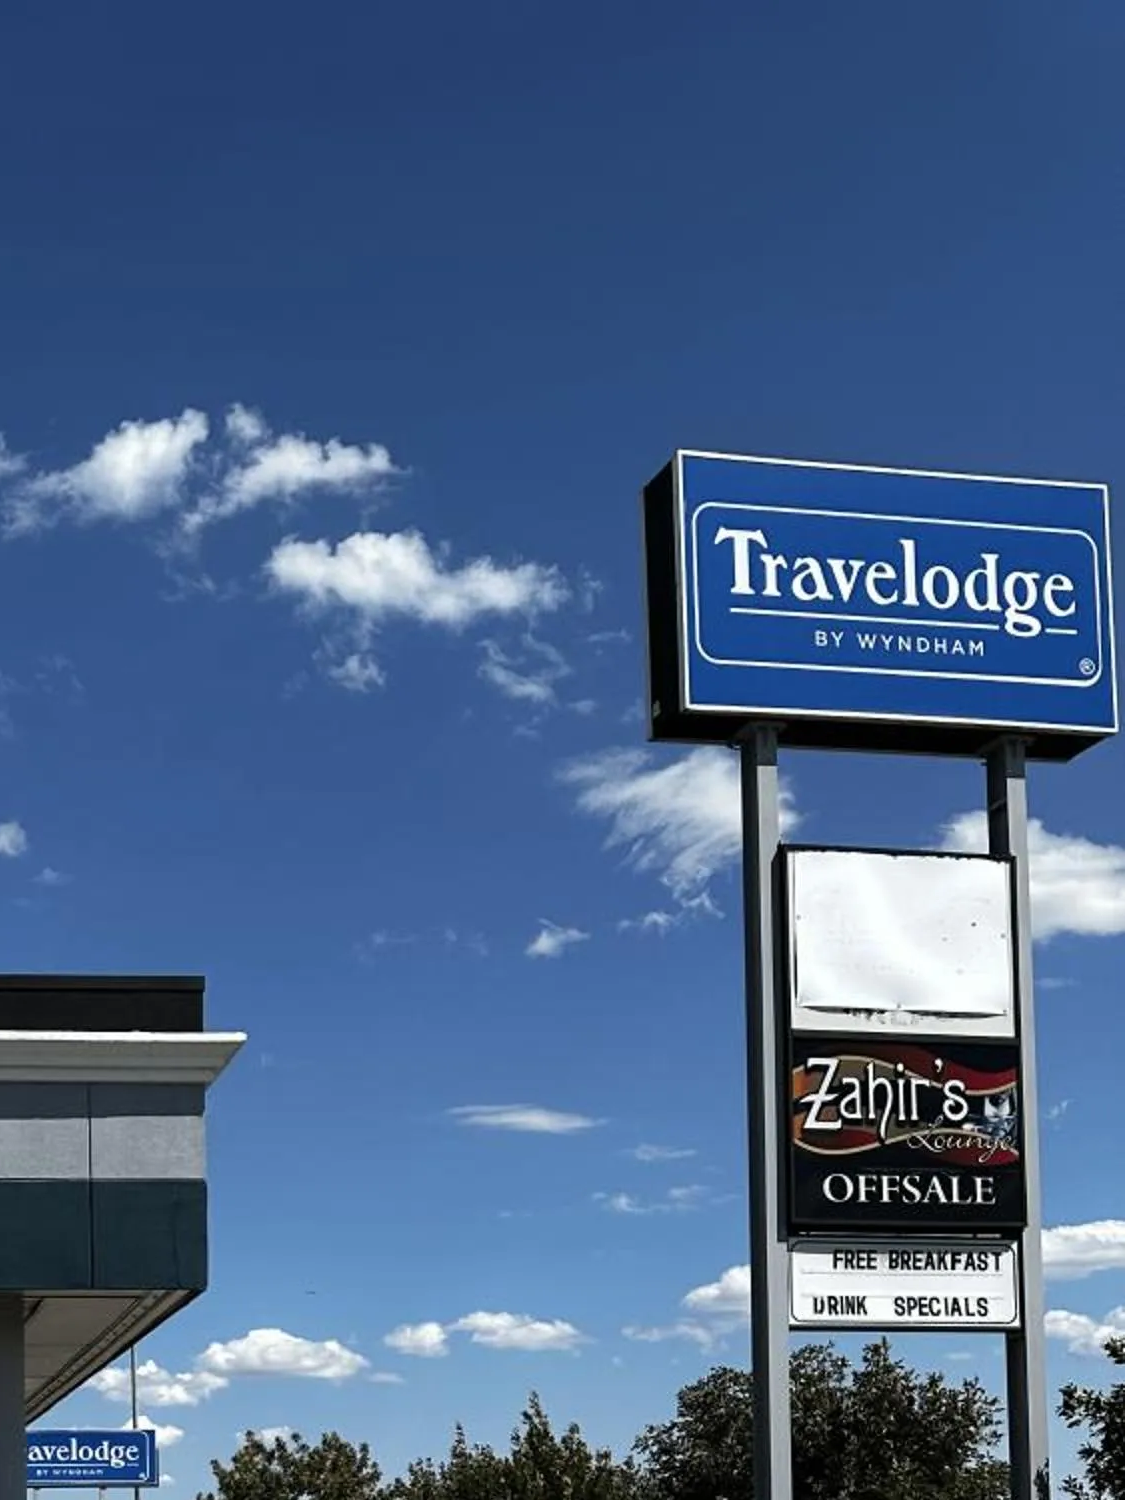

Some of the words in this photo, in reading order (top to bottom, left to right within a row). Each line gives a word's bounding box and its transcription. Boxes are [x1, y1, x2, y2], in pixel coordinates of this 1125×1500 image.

[713, 525, 1077, 638] Travelodge
[814, 630, 845, 648] BY
[857, 632, 985, 657] WYNDHAM
[800, 1056, 969, 1145] Zahir's
[823, 1173, 996, 1205] OFFSALE
[832, 1251, 878, 1271] FREE
[888, 1251, 1002, 1272] BREAKFAST
[813, 1296, 867, 1317] DRINK
[894, 1296, 988, 1317] SPECIALS
[28, 1437, 140, 1469] avelodge
